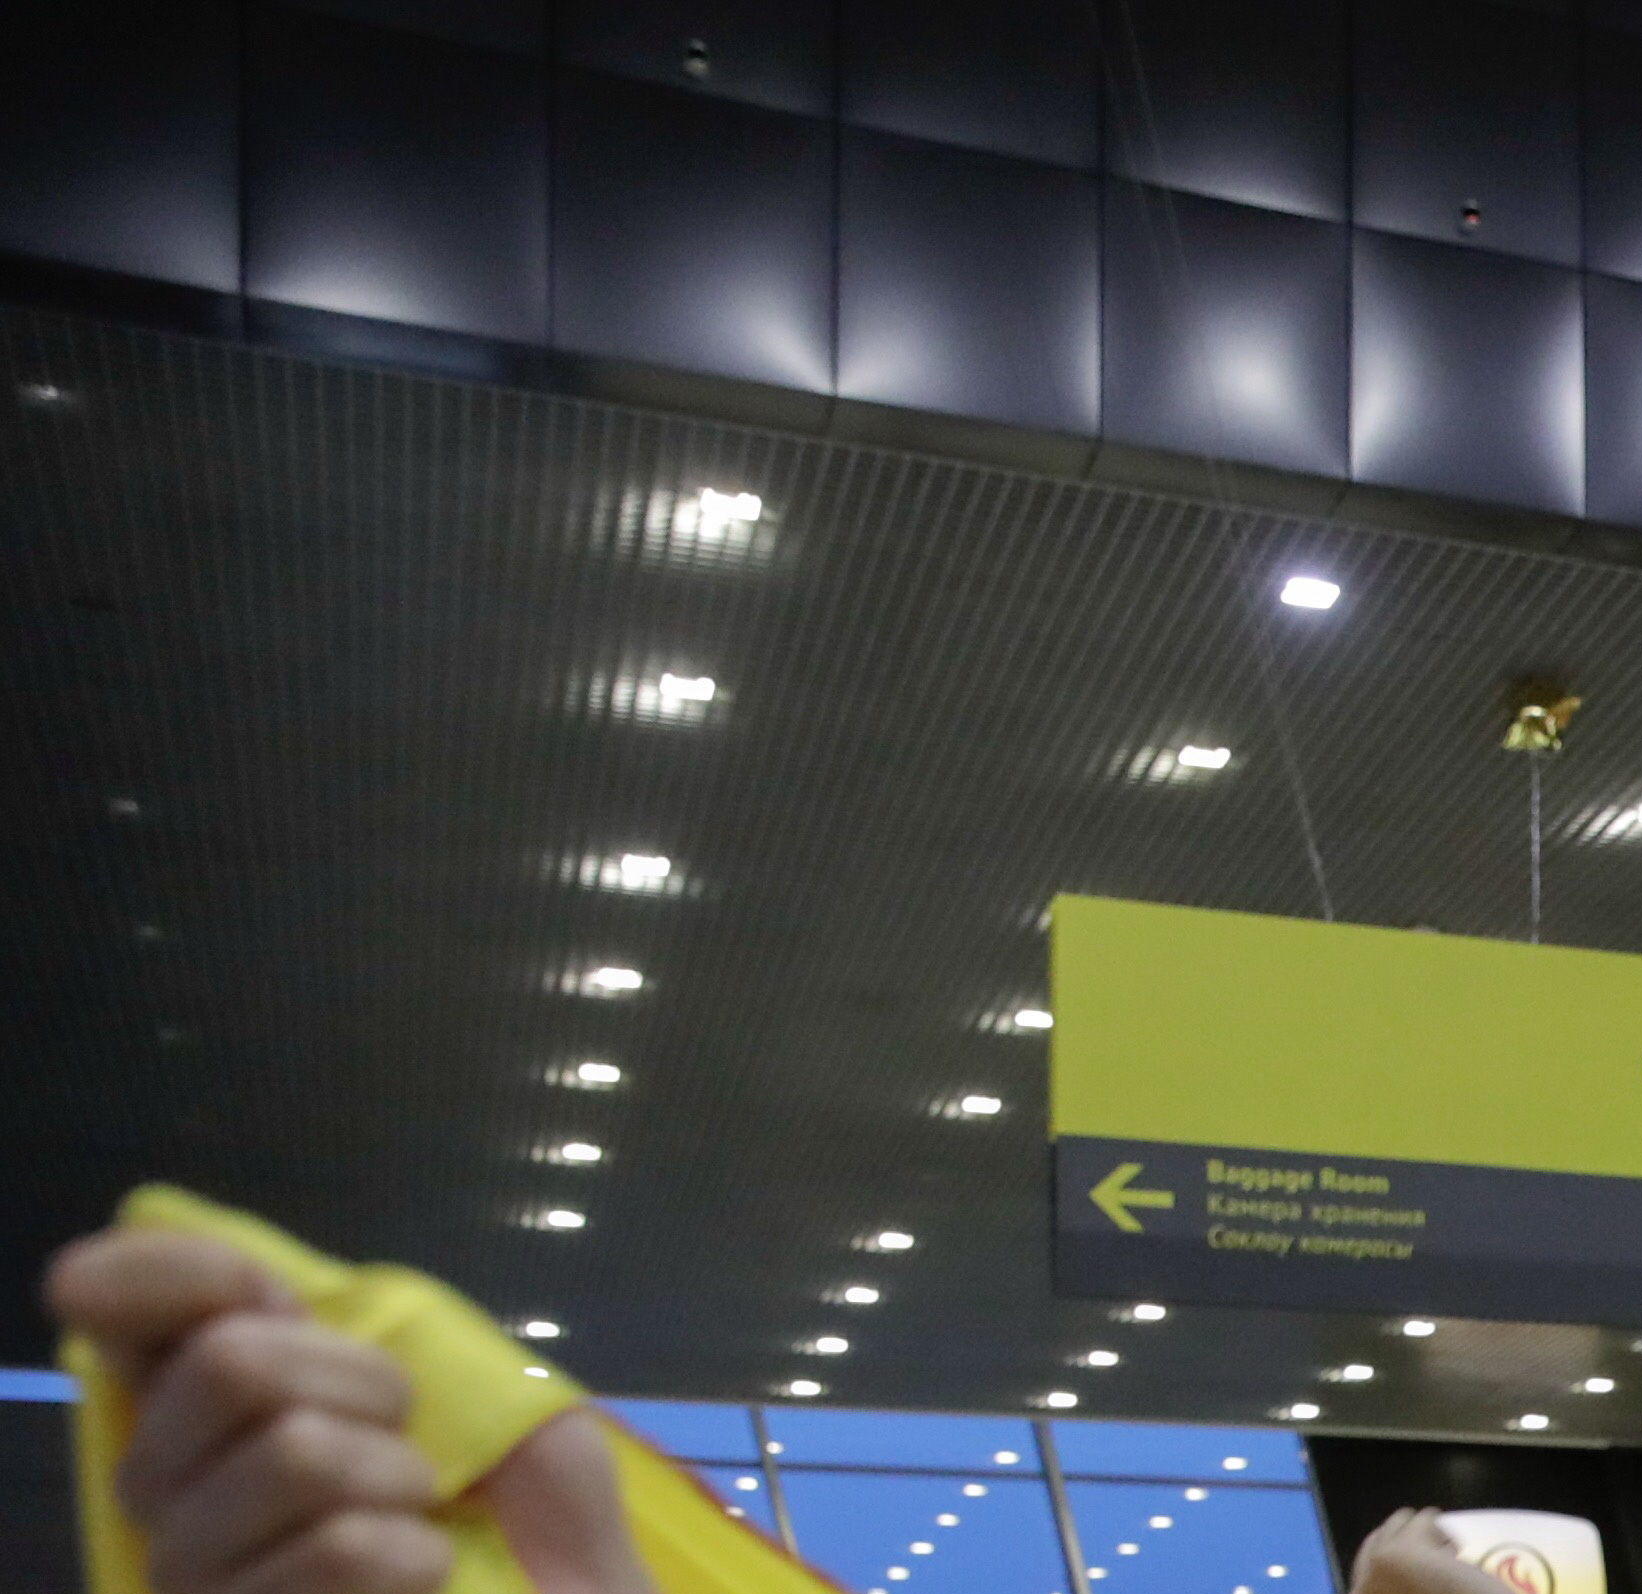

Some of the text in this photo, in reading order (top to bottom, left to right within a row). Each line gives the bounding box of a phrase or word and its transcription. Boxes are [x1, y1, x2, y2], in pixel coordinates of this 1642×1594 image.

[1206, 1159, 1391, 1195] Baggage Room
[1206, 1193, 1427, 1227] Камера хранения
